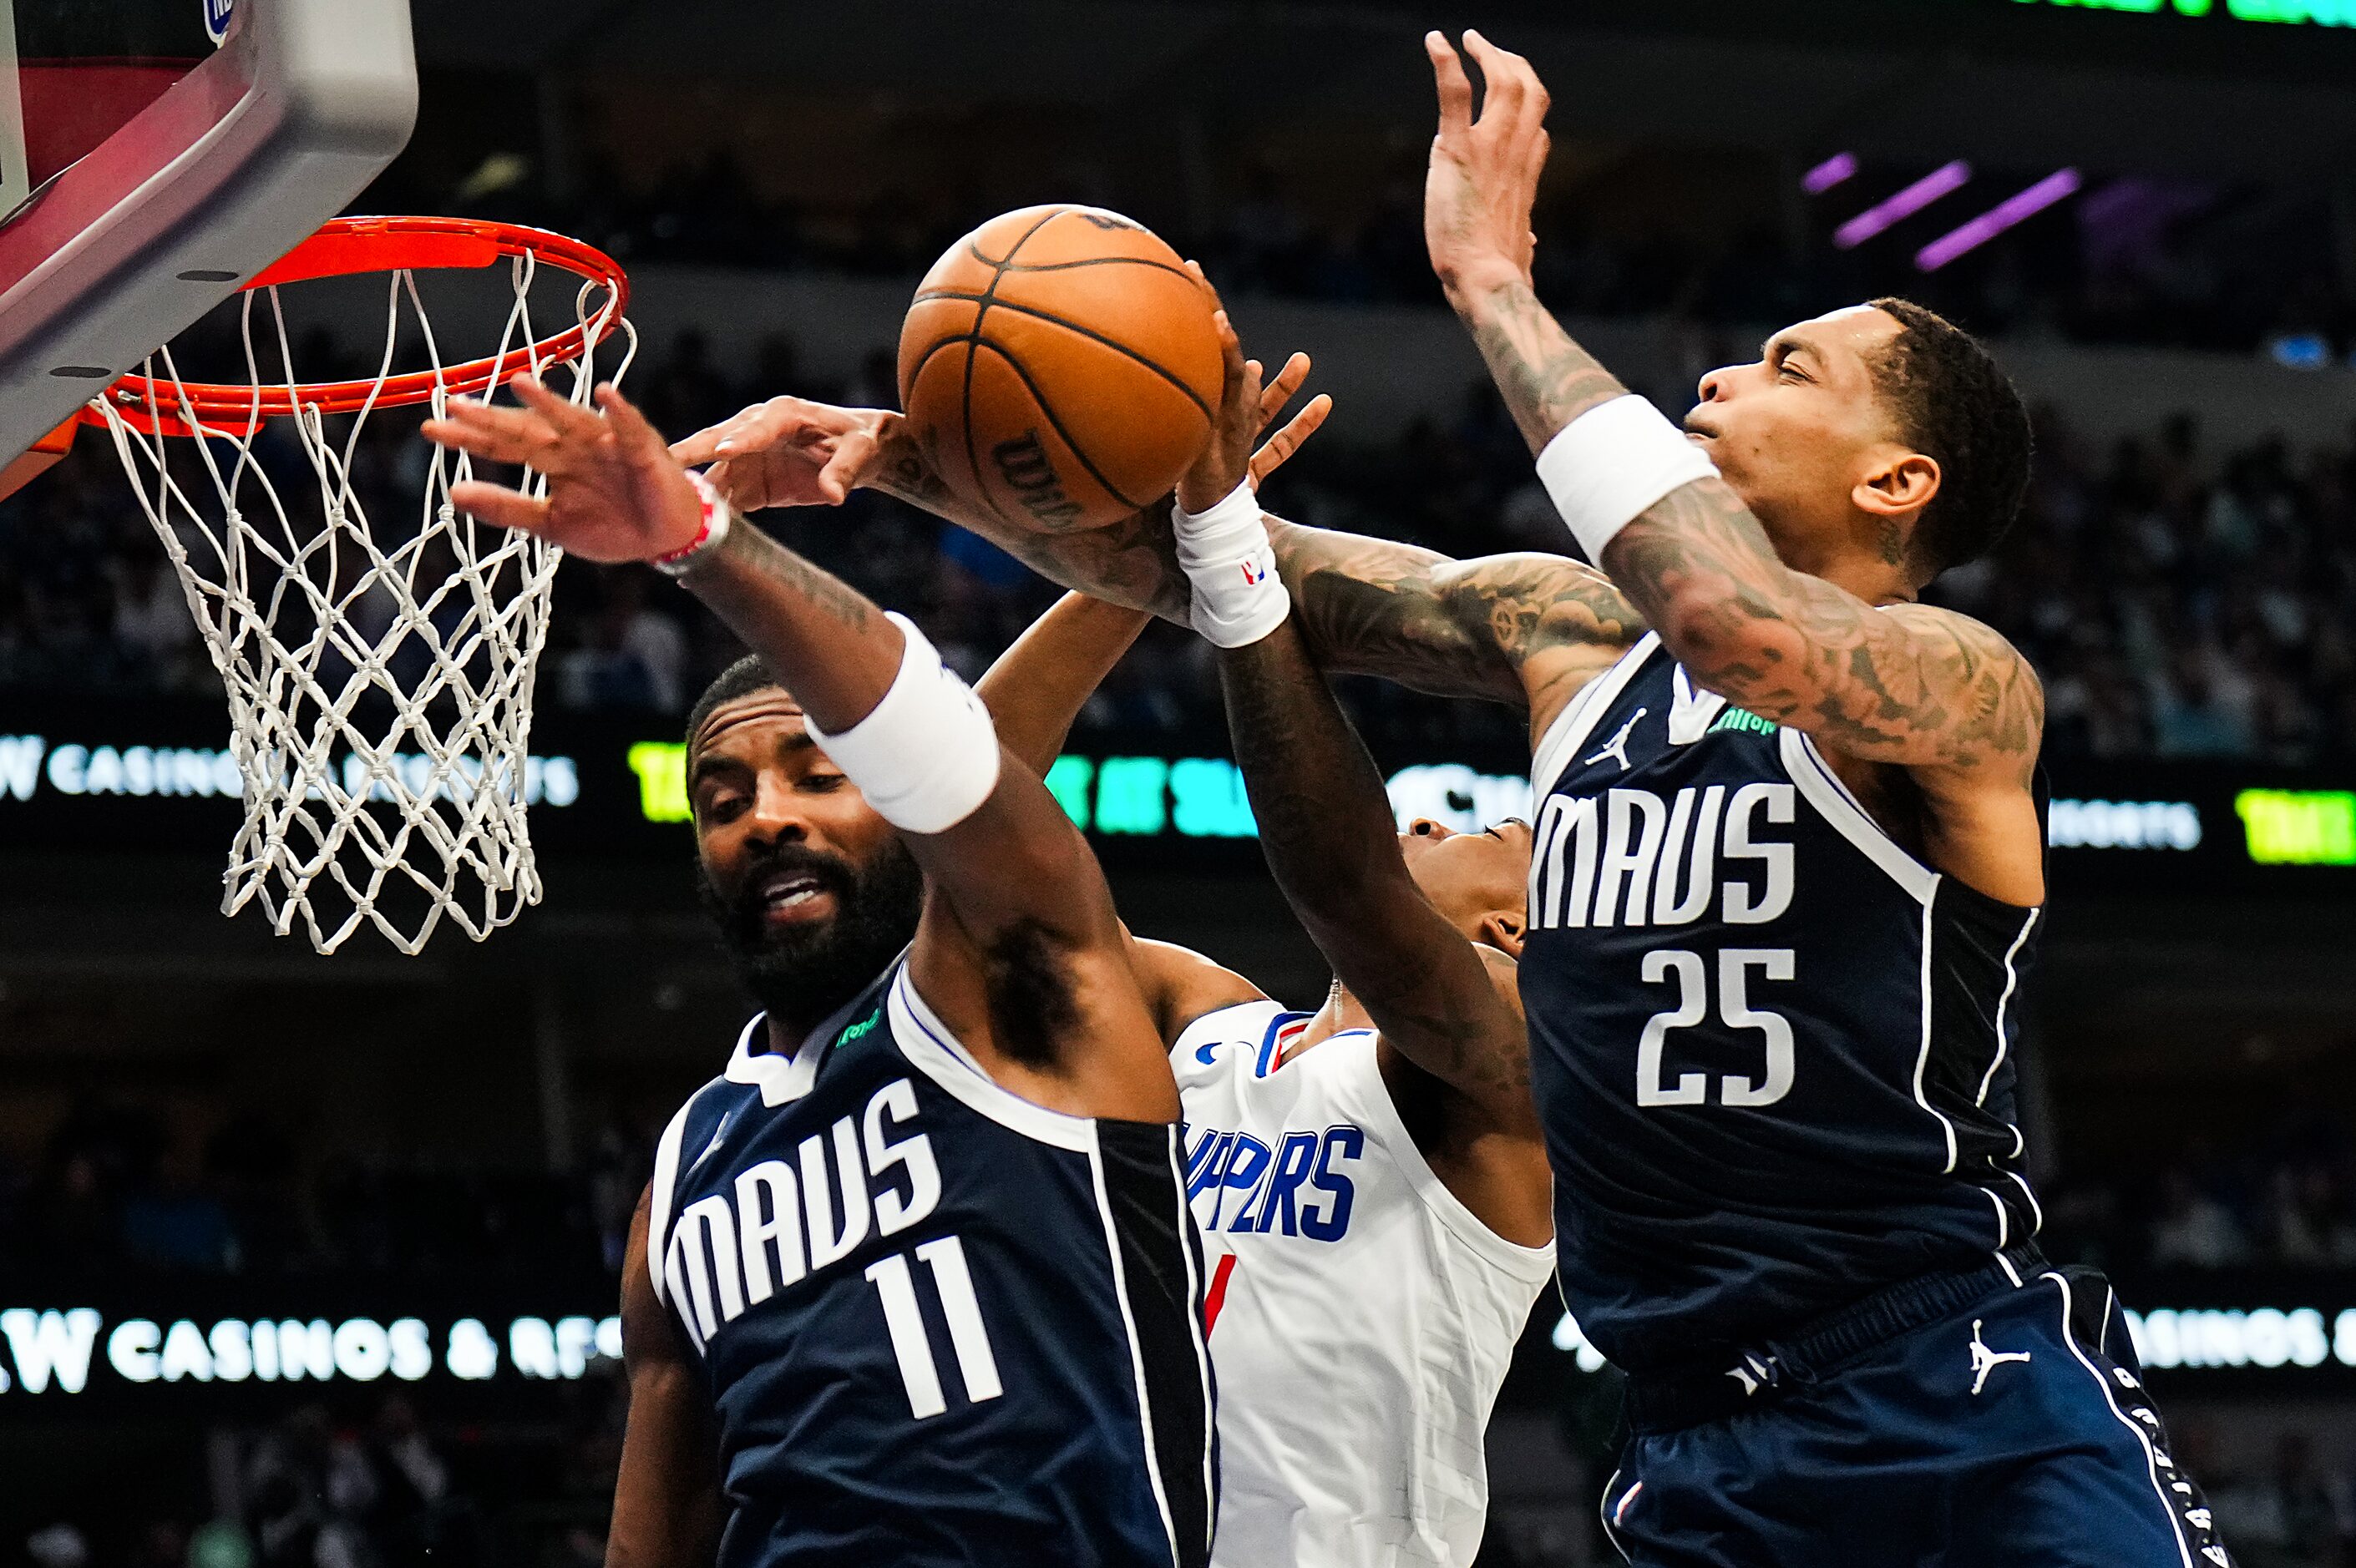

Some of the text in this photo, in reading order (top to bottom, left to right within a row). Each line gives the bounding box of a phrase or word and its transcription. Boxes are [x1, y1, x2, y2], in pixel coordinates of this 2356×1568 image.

[1527, 783, 1795, 930] MAVS
[1636, 948, 1795, 1107] 25
[665, 1077, 942, 1358] MAVS
[108, 1318, 432, 1382] CASINOS
[447, 1318, 498, 1381] &
[864, 1235, 1003, 1419] 11
